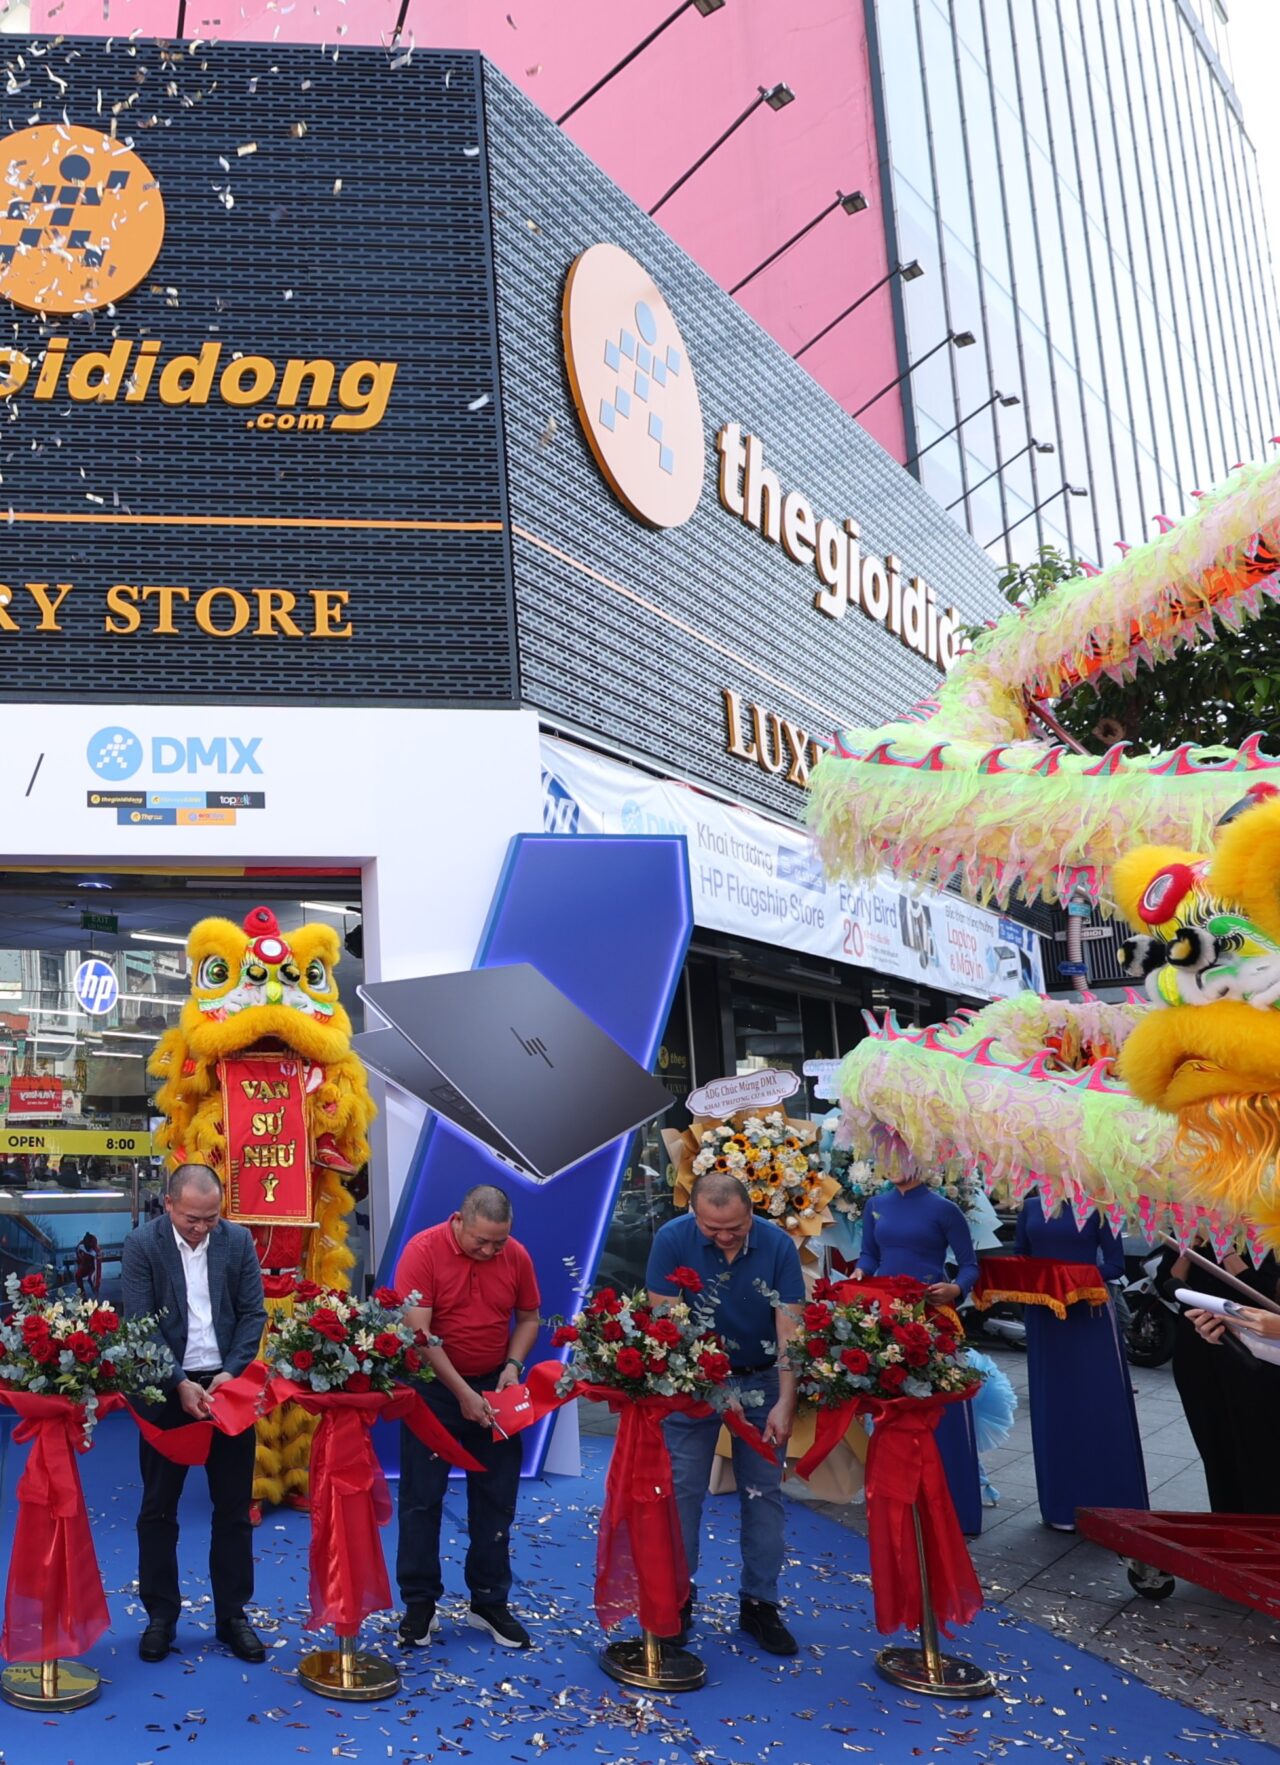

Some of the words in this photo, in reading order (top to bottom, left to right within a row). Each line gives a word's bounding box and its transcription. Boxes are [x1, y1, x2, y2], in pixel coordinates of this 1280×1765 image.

[246, 410, 325, 431] .com
[106, 584, 352, 638] STORE
[151, 737, 264, 774] DMX
[697, 822, 728, 856] Khai
[700, 865, 724, 898] HP
[726, 872, 788, 922] Flagship
[790, 894, 825, 929] Store
[839, 883, 872, 926] Early
[873, 894, 898, 929] Bird
[843, 918, 864, 957] 20
[947, 921, 977, 953] Laptop
[78, 963, 116, 1010] hp
[241, 1081, 290, 1103] VẠN
[705, 1087, 720, 1100] ADG
[721, 1083, 738, 1096] Chúc
[760, 1074, 777, 1087] DMX
[252, 1106, 285, 1142] SỰ
[8, 1135, 45, 1148] OPEN
[106, 1138, 135, 1150] 8:00
[242, 1140, 296, 1168] NHƯ
[261, 1173, 279, 1202] Ý
